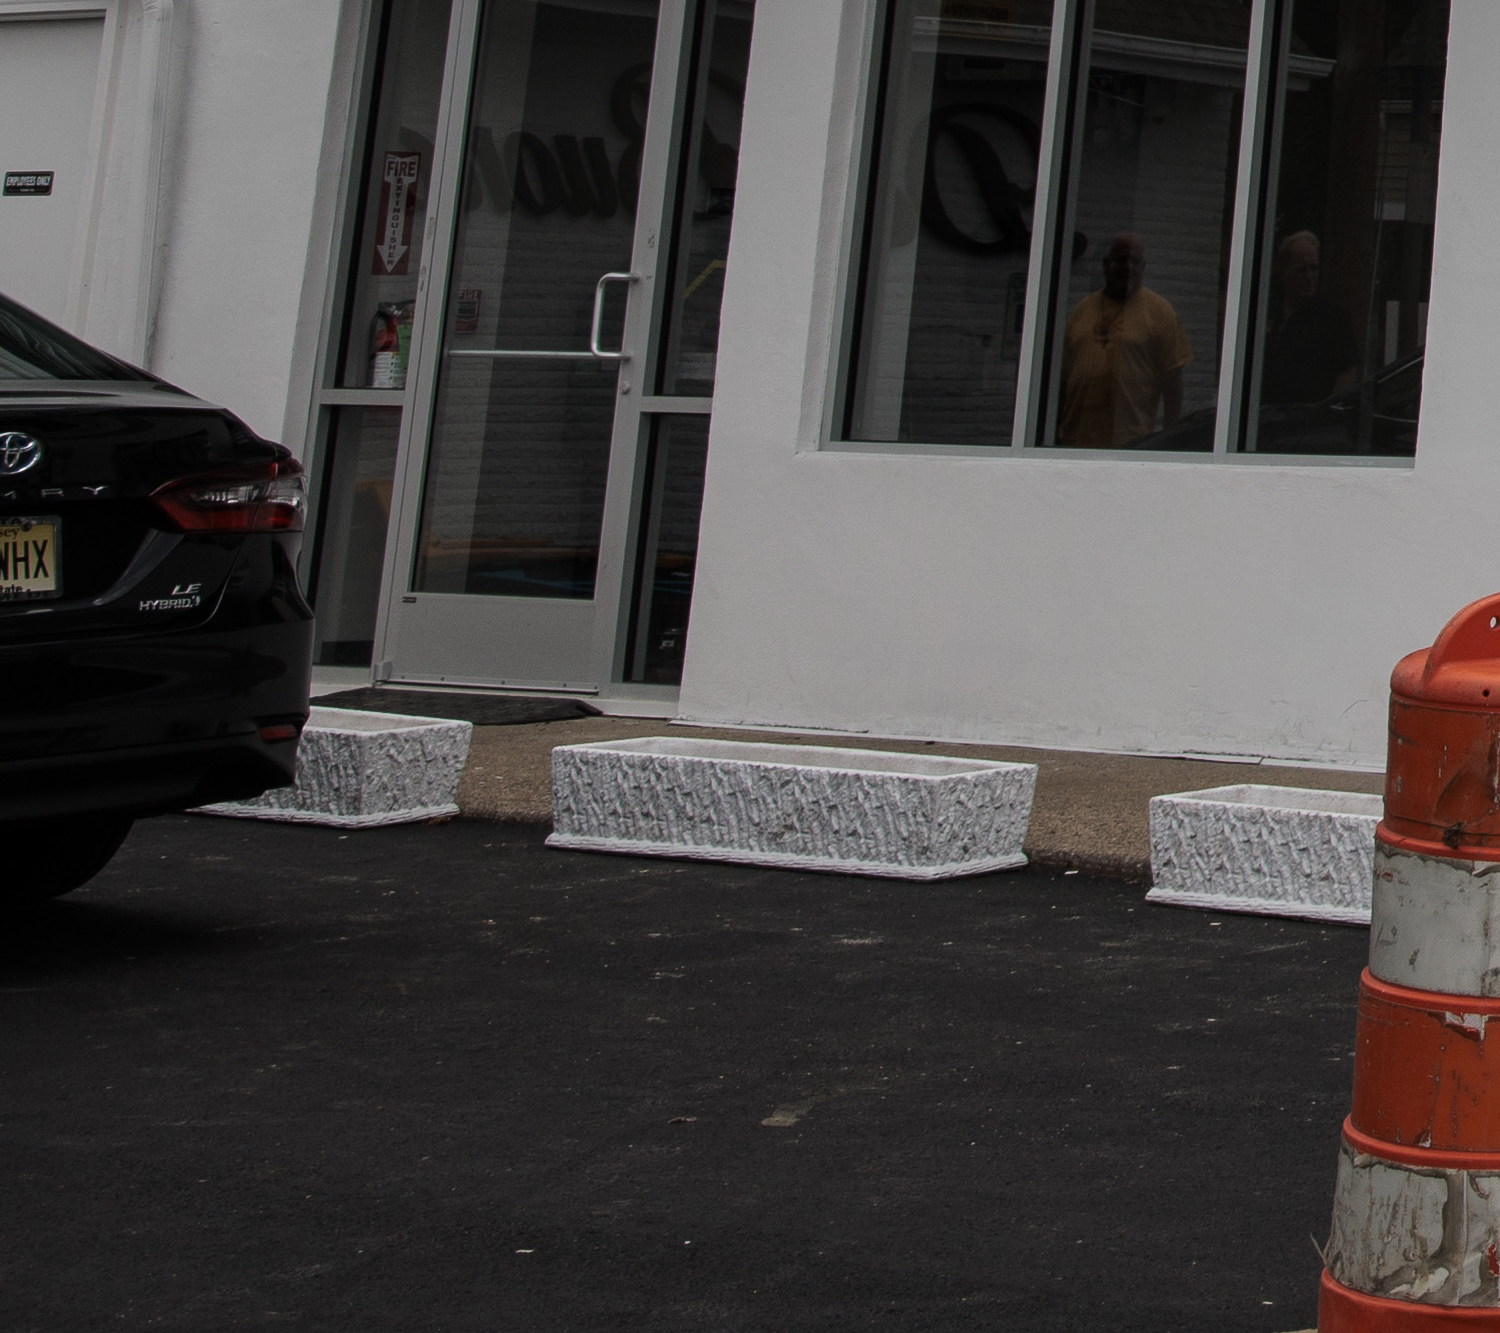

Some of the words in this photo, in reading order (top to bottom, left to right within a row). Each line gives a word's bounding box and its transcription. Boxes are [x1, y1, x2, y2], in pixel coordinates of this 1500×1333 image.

[387, 161, 416, 177] FIRE
[387, 177, 404, 266] EXTINGUISHER
[171, 582, 203, 596] LE
